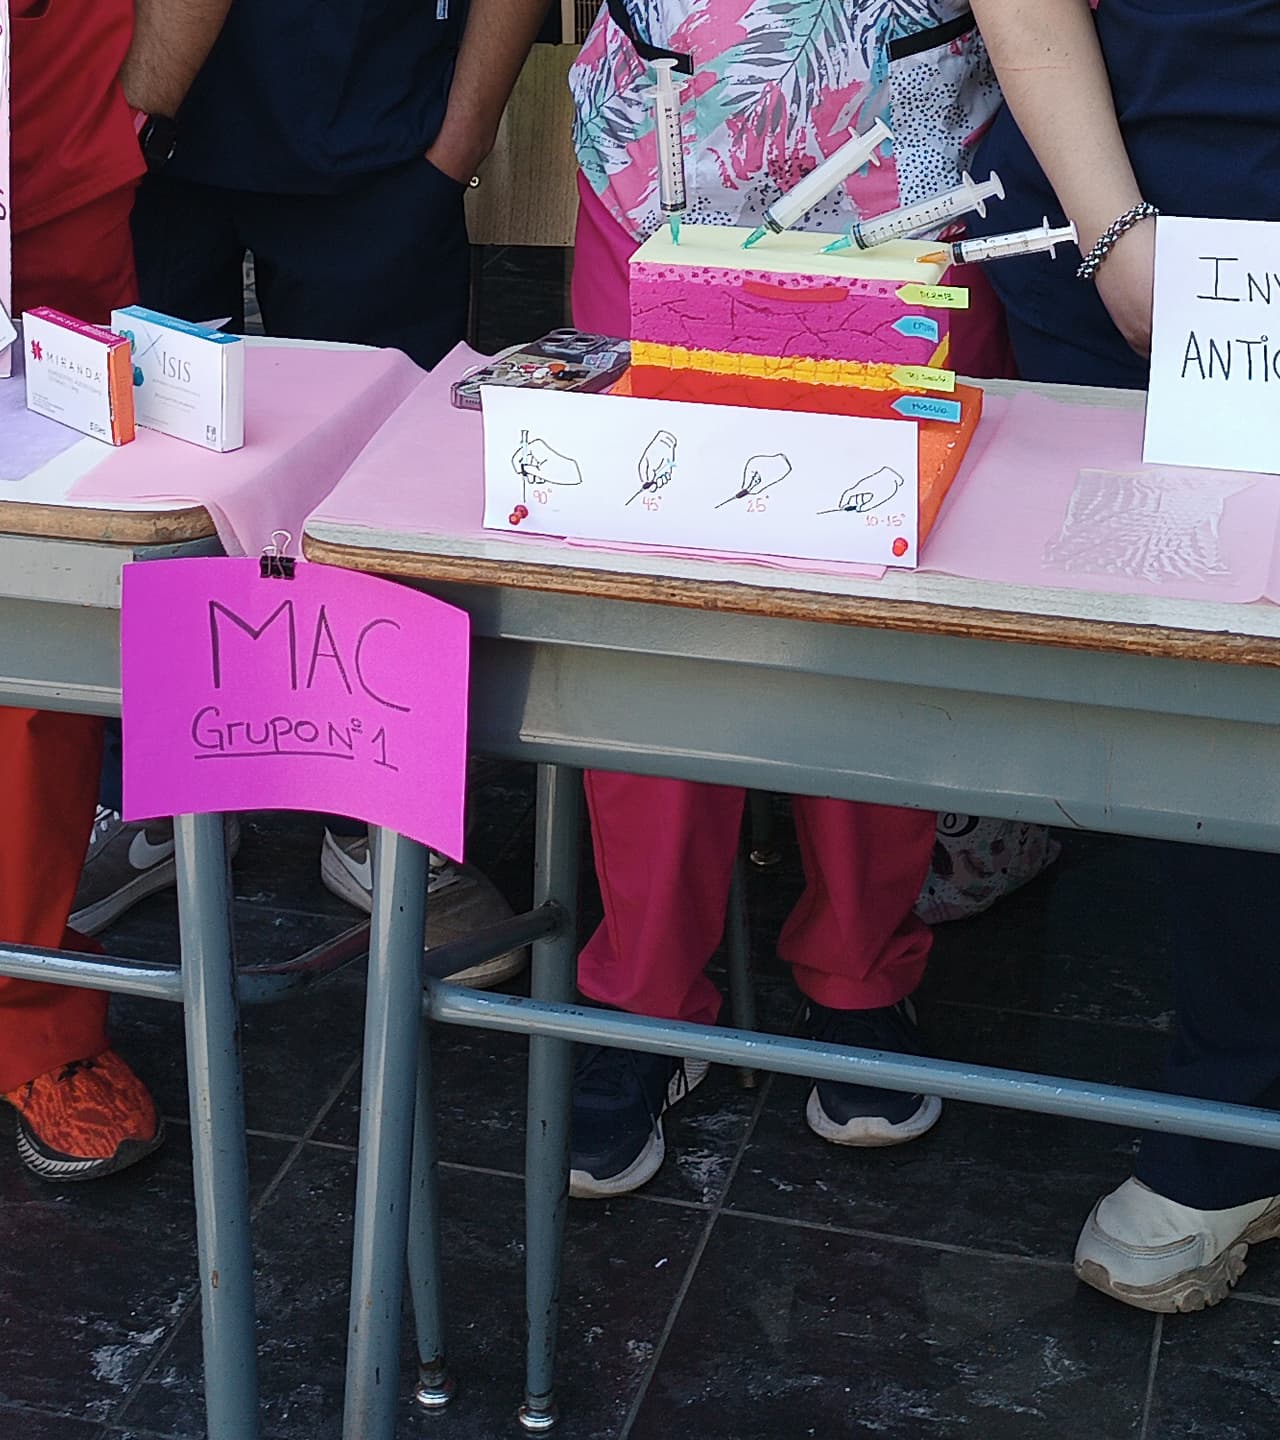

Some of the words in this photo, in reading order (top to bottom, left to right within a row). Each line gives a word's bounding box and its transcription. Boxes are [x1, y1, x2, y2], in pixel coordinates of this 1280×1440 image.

[46, 352, 102, 383] MIRANDA
[209, 599, 411, 713] MAC
[371, 727, 399, 772] 1
